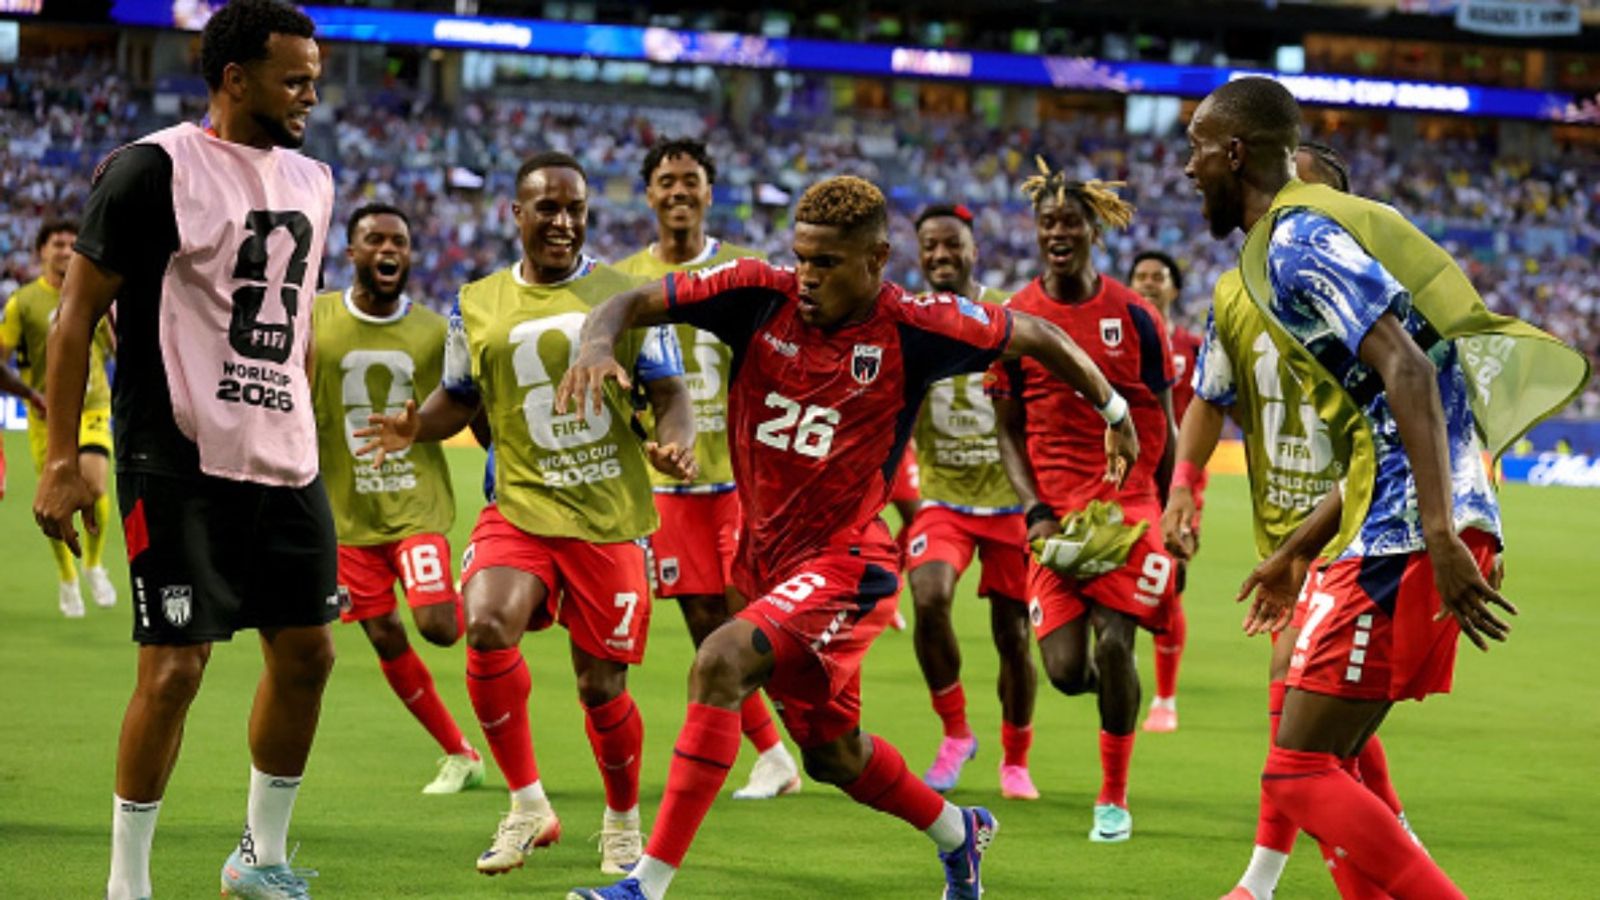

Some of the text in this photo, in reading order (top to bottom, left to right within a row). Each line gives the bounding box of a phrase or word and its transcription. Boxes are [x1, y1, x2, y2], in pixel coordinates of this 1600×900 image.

[223, 361, 273, 382] WORL
[216, 379, 294, 412] 2026
[551, 420, 593, 438] FIFA
[756, 391, 841, 458] 26
[537, 443, 618, 471] WORLD CUP
[1277, 442, 1311, 460] FIFA
[356, 474, 416, 494] 2026
[543, 459, 621, 488] 2026
[402, 544, 443, 589] 16
[1136, 553, 1170, 595] 9
[613, 592, 638, 636] 7
[1296, 592, 1336, 652] 7
